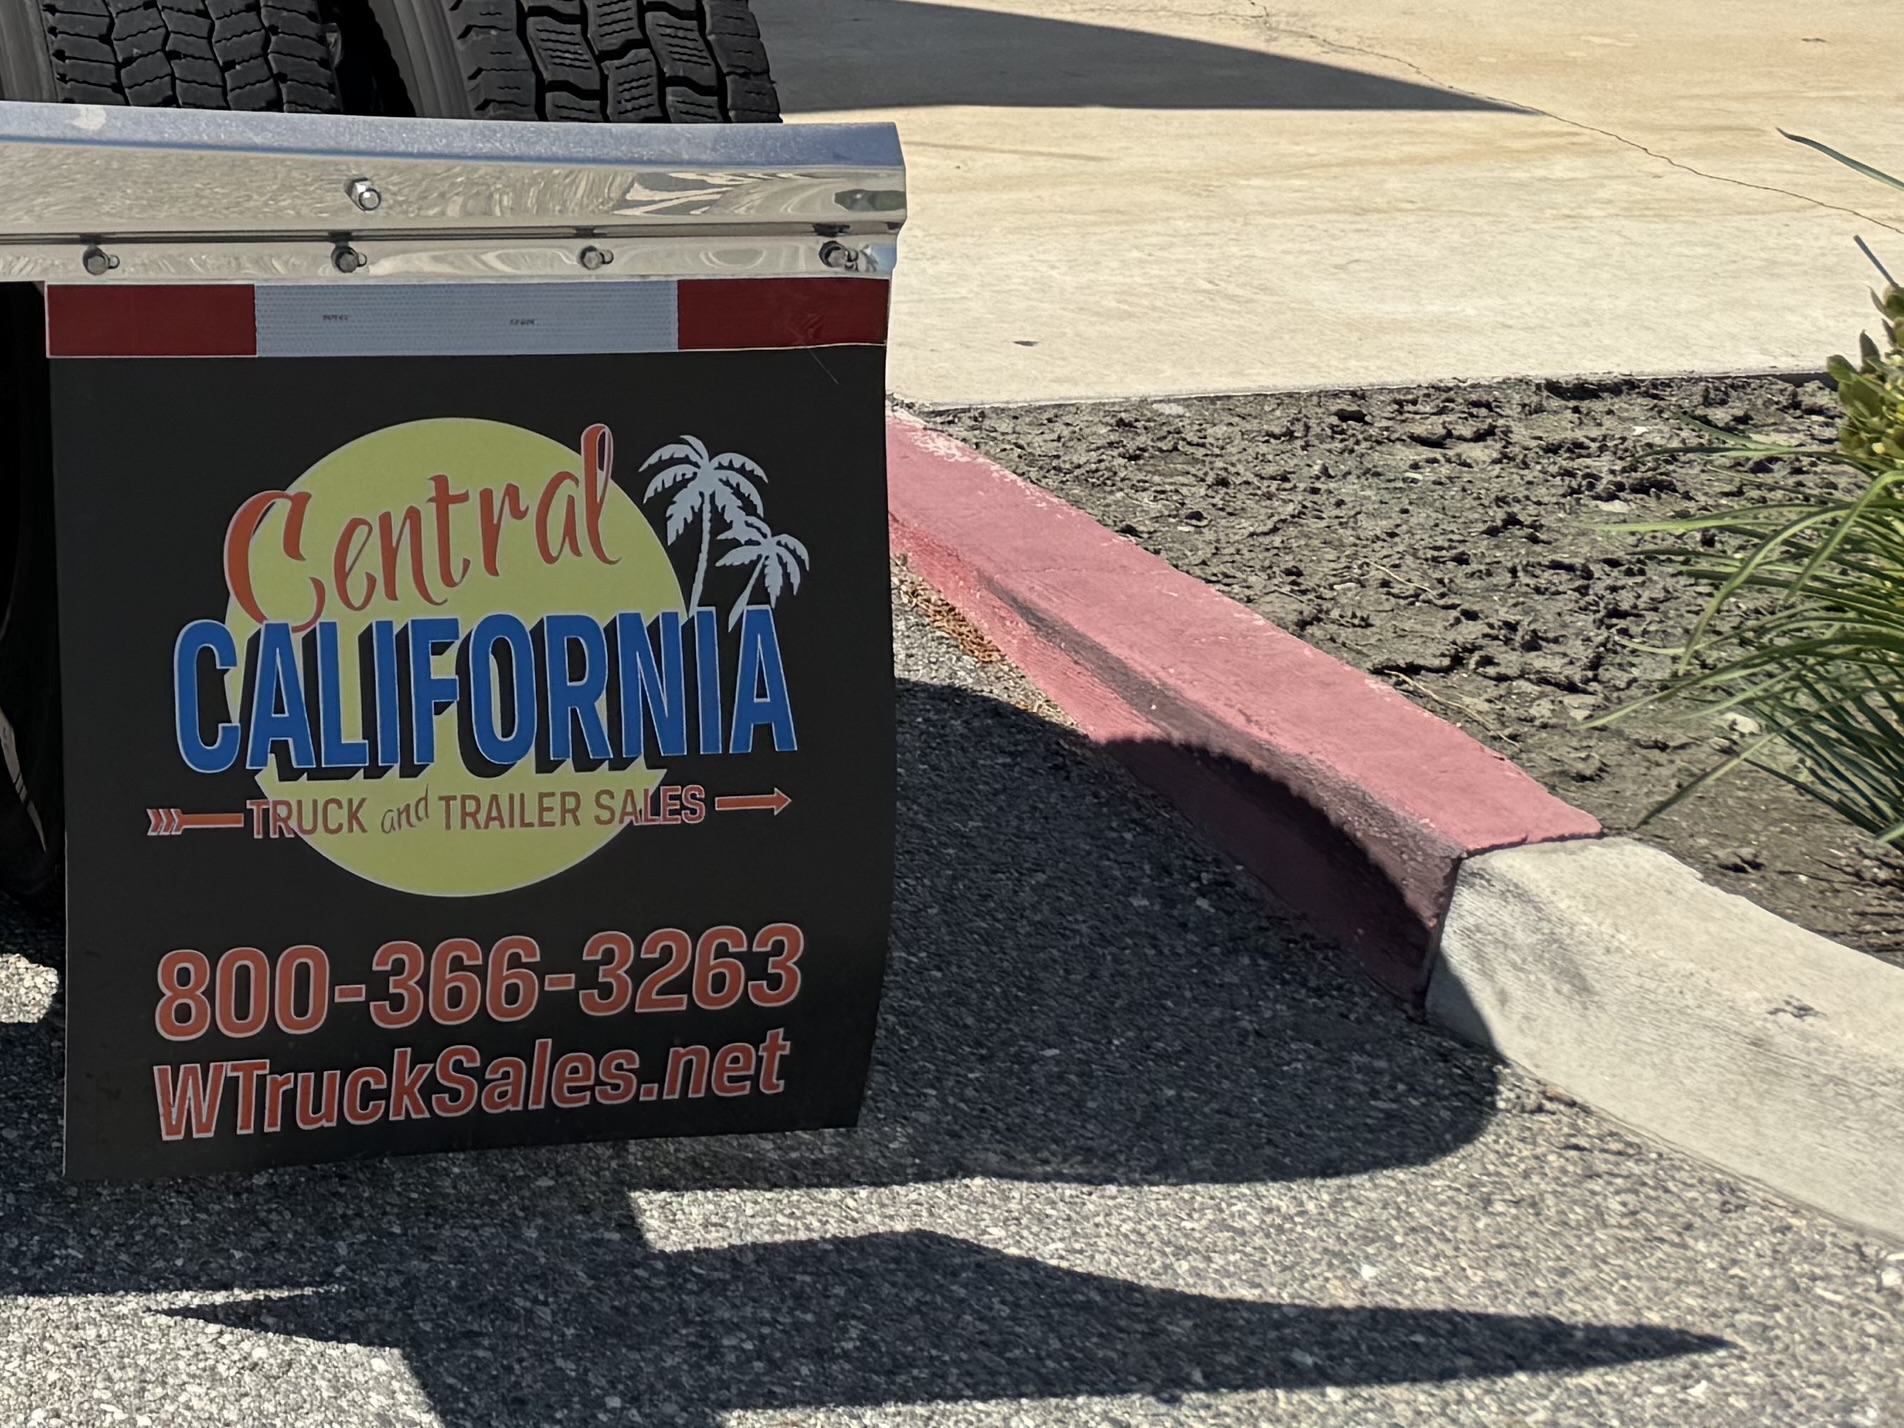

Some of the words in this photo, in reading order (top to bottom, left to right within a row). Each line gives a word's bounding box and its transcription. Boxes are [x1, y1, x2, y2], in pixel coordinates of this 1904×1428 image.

[224, 423, 622, 633] Central
[173, 605, 797, 776] CALIFORNIA
[245, 797, 368, 839] TRUCK
[380, 783, 430, 834] and
[437, 791, 582, 831] TRAILER
[594, 784, 705, 826] SALES
[155, 923, 804, 1042] 800-366-3263
[153, 1028, 790, 1141] WTruckSales.net
